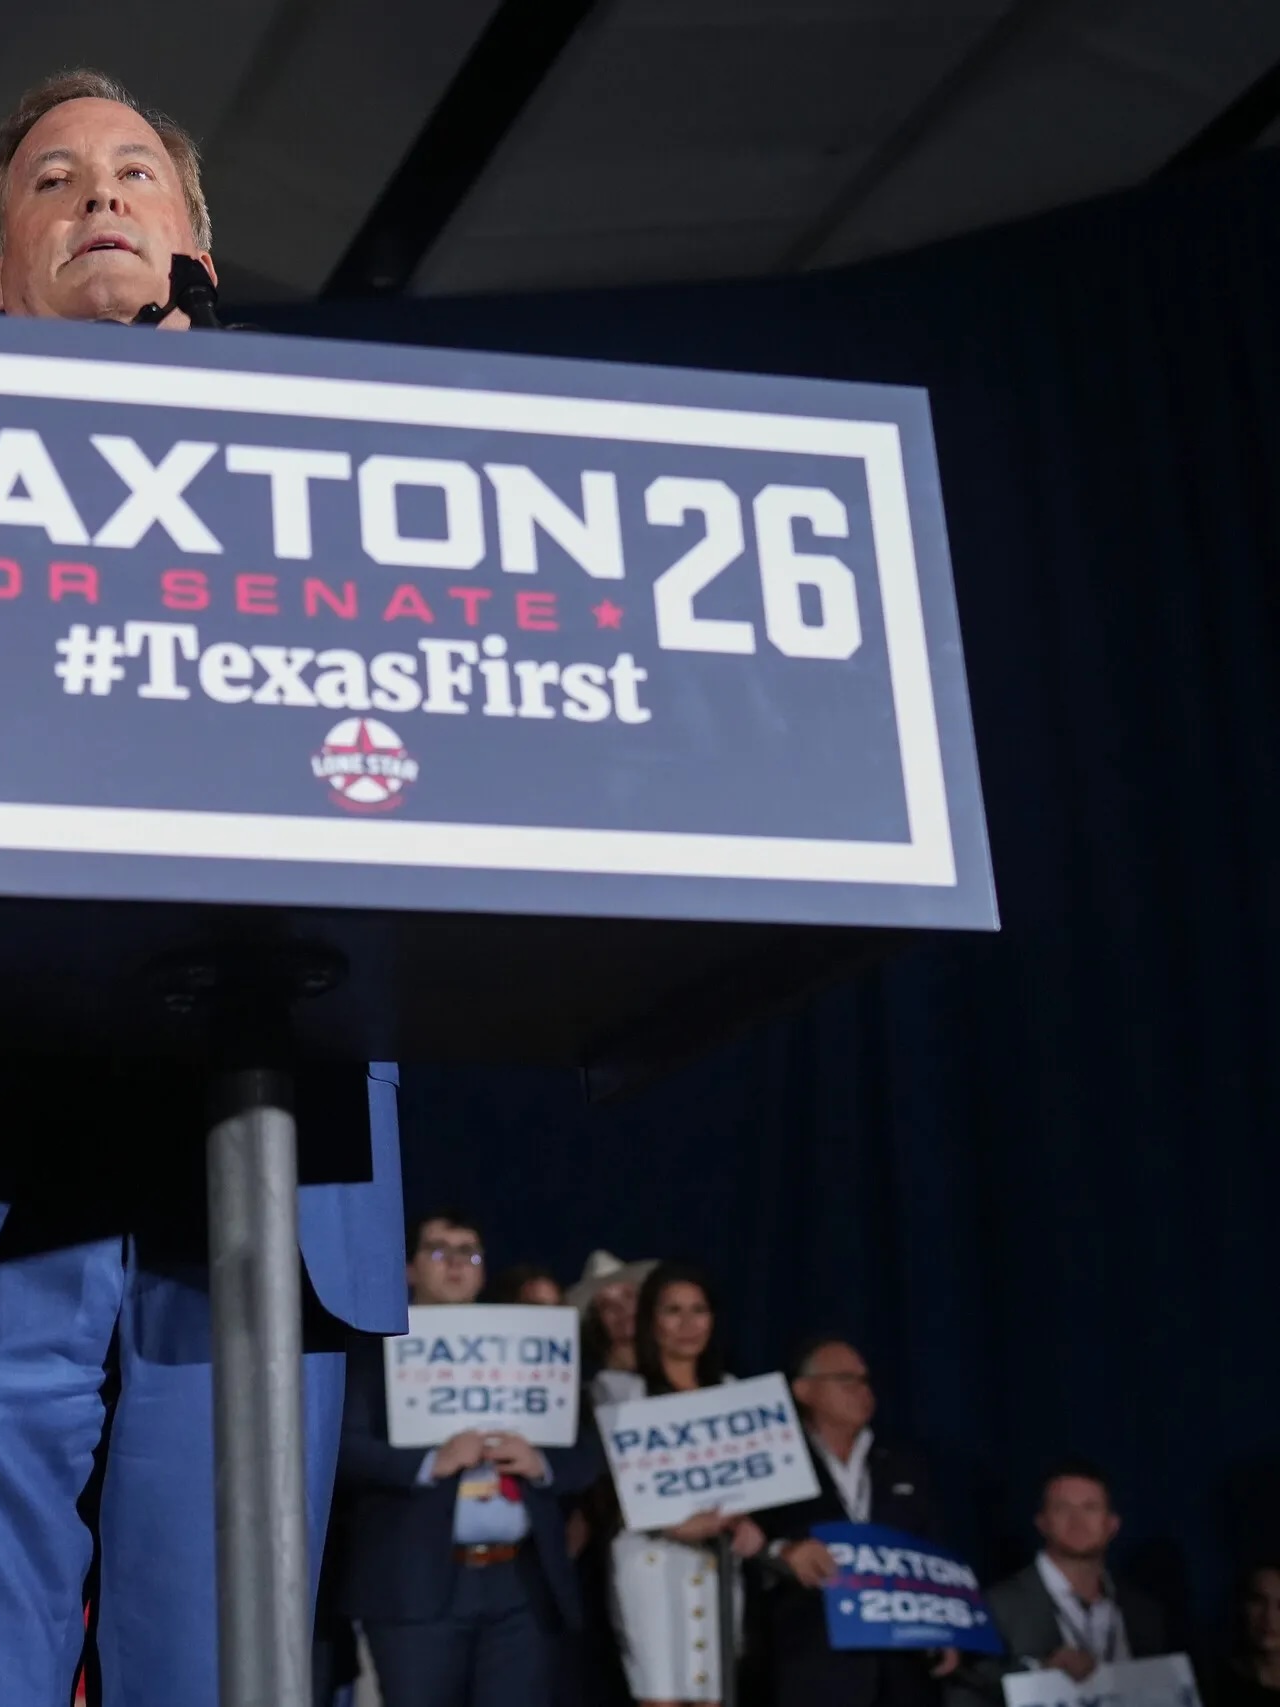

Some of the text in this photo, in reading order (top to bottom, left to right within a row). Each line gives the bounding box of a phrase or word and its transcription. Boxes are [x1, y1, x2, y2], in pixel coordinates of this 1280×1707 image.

[644, 476, 862, 660] 26
[160, 569, 559, 631] SENATE
[55, 619, 652, 724] #TexasFirst
[396, 1336, 572, 1366] PAXTON
[428, 1386, 549, 1415] 2026
[612, 1402, 788, 1454] PAXTON
[653, 1451, 774, 1497] 2026
